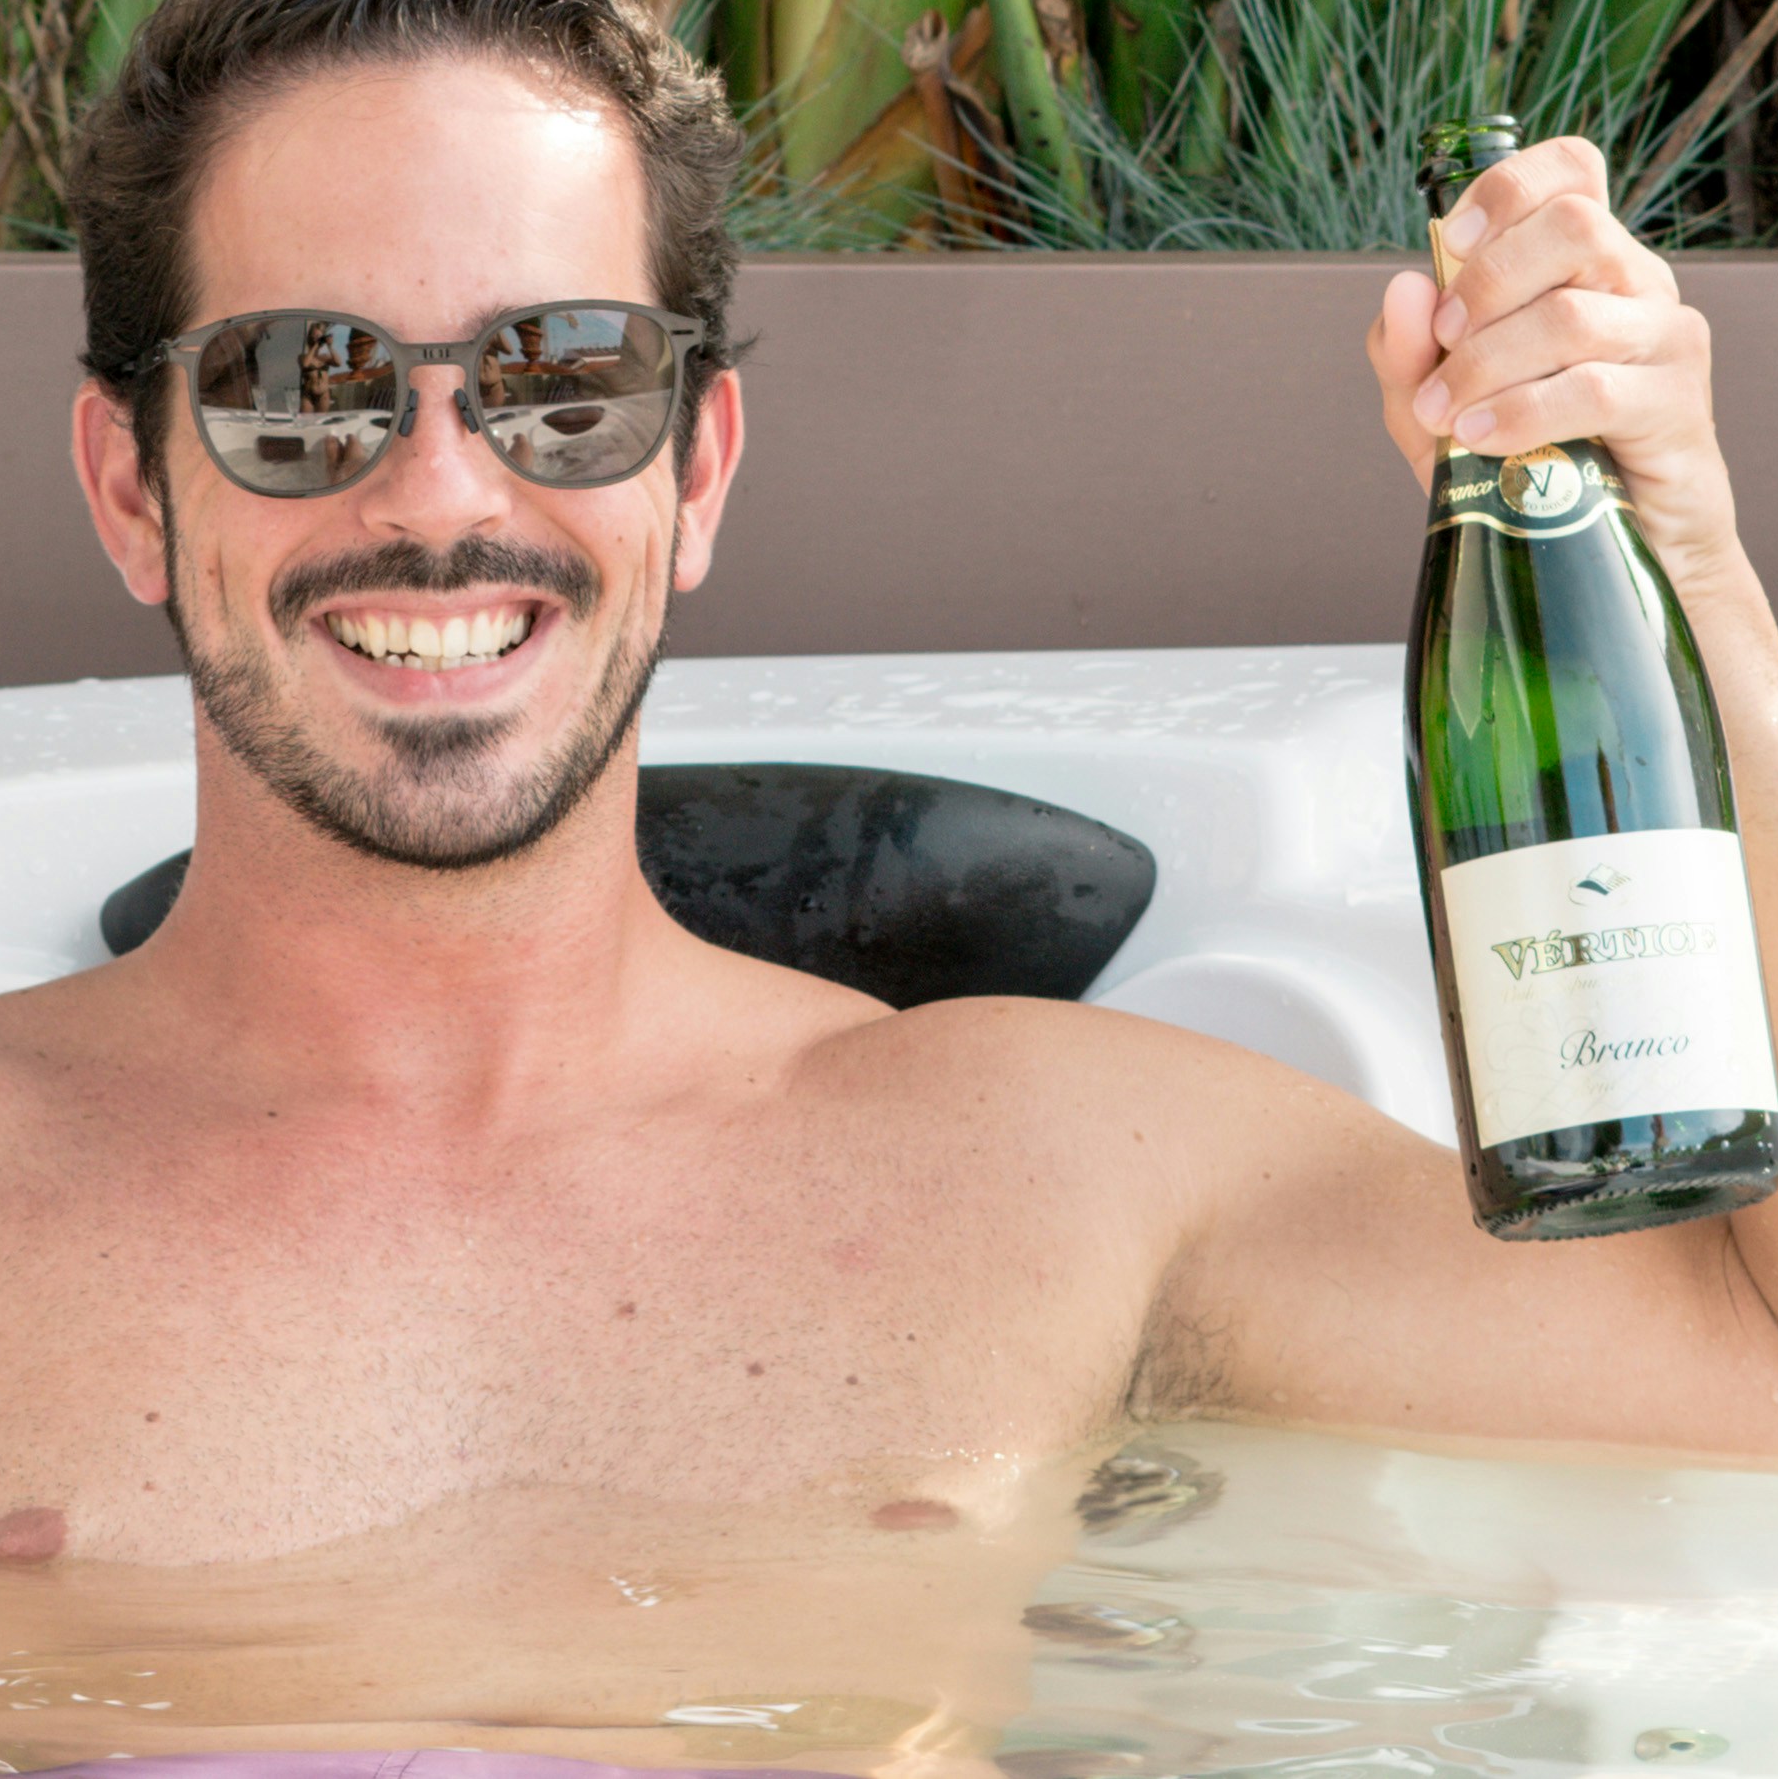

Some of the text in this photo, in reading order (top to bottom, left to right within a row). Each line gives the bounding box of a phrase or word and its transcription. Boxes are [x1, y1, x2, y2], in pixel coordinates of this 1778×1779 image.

[1523, 464, 1554, 497] V
[1491, 921, 1719, 980] VÉRTICE
[1560, 1029, 1690, 1070] Branco
